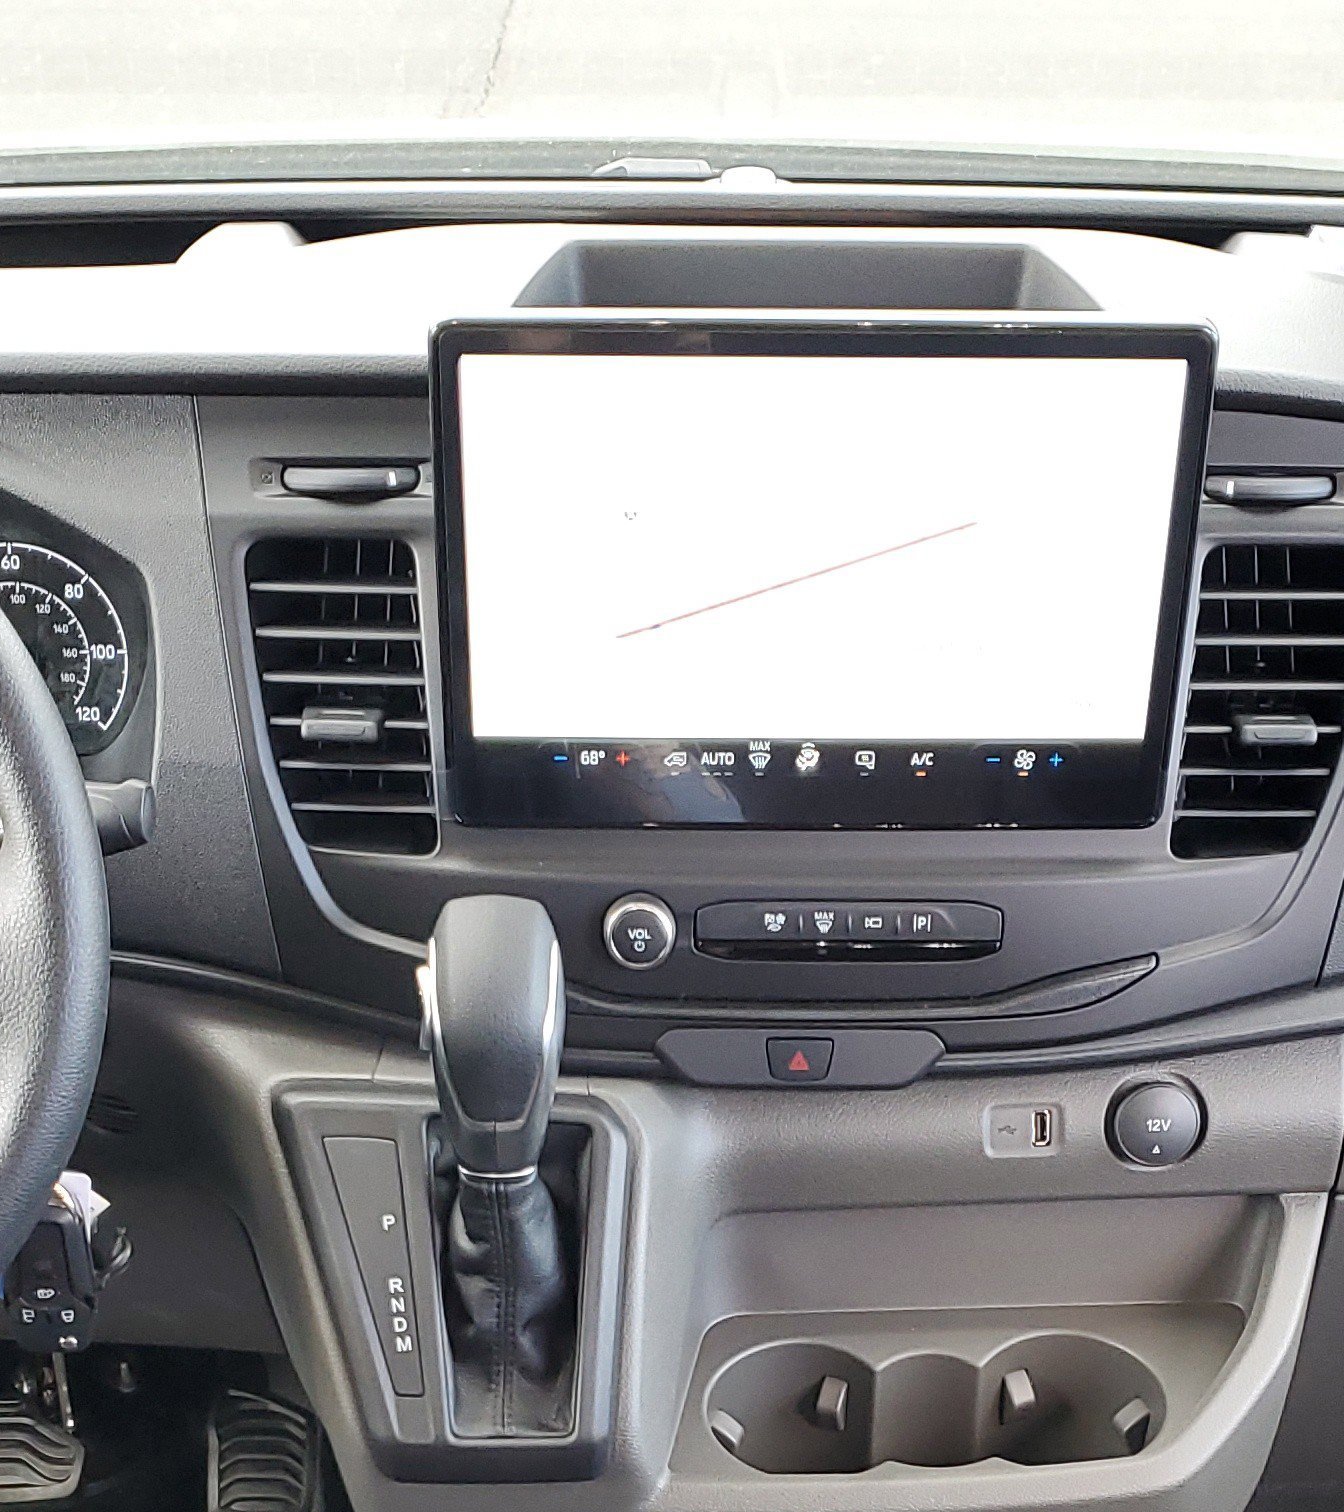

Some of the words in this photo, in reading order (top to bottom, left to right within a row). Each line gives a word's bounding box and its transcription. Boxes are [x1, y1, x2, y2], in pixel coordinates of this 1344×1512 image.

[0, 555, 20, 570] 60
[64, 584, 83, 599] 80
[9, 594, 25, 604] 100
[35, 604, 51, 614] 120
[53, 624, 69, 634] 140
[62, 647, 77, 658] 160
[90, 644, 115, 659] 100
[60, 672, 75, 683] 180
[75, 707, 100, 721] 120
[749, 741, 771, 751] MAX
[701, 752, 735, 766] AUTO
[910, 752, 934, 766] A/C
[814, 911, 835, 920] MAX
[627, 928, 652, 940] VOL
[1146, 1119, 1171, 1133] 12V
[382, 1214, 396, 1232] P
[388, 1277, 404, 1294] R
[390, 1297, 406, 1313] N
[393, 1317, 408, 1333] D
[396, 1336, 413, 1353] M
